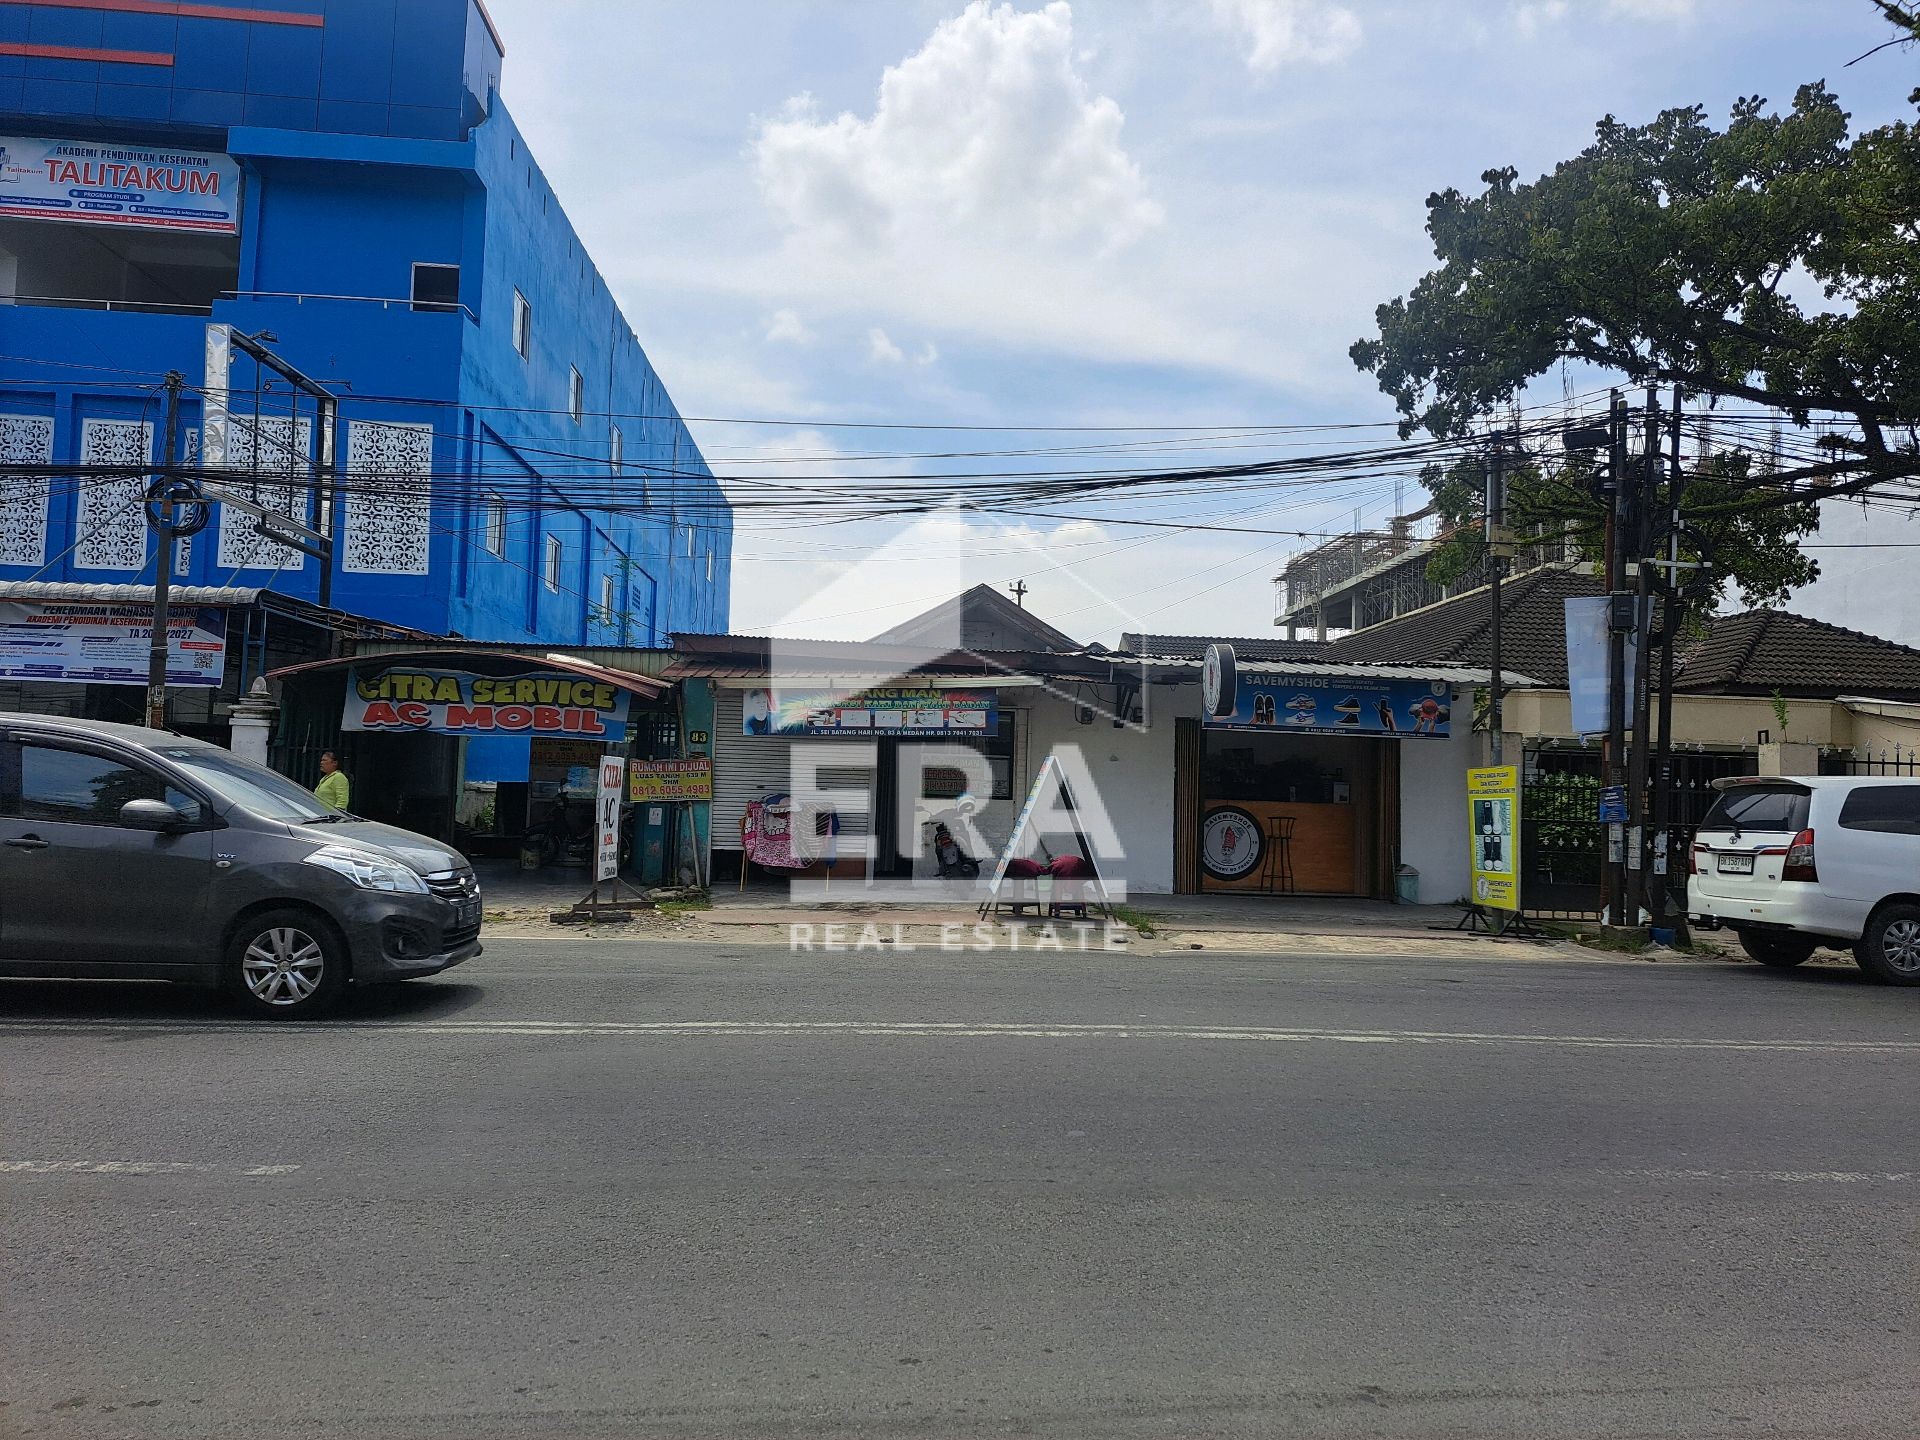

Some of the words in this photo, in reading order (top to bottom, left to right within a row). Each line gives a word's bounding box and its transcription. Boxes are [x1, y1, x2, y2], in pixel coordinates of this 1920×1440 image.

[56, 146, 97, 158] AKADEMI
[101, 149, 155, 163] PENDIDIKAN
[159, 154, 209, 167] KESEHATAN
[6, 166, 43, 175] Talitakum
[44, 159, 219, 195] TALITAKUM
[84, 192, 113, 200] PROGRAM
[43, 605, 107, 616] PENERIMAAN
[26, 615, 62, 624] AKADEMI
[63, 616, 108, 625] PENDIDIKAN
[110, 617, 152, 627] KESEHATAN
[129, 628, 140, 638] TA
[1246, 675, 1329, 688] SAVEMYSHOE
[356, 674, 461, 702] CITRA
[473, 679, 615, 709] SERVICE
[849, 688, 897, 699] BANG
[902, 688, 941, 698] MAN
[361, 702, 431, 726] AC
[446, 704, 605, 734] MOBIL
[631, 762, 662, 772] RUMAH
[665, 762, 677, 772] INI
[679, 761, 709, 771] DIJUAL
[603, 764, 621, 789] CITRA
[632, 786, 656, 795] 0812
[660, 785, 683, 795] 6055
[686, 784, 710, 794] 4983
[603, 797, 615, 829] AC
[1205, 814, 1252, 829] SAVEMYSHOE
